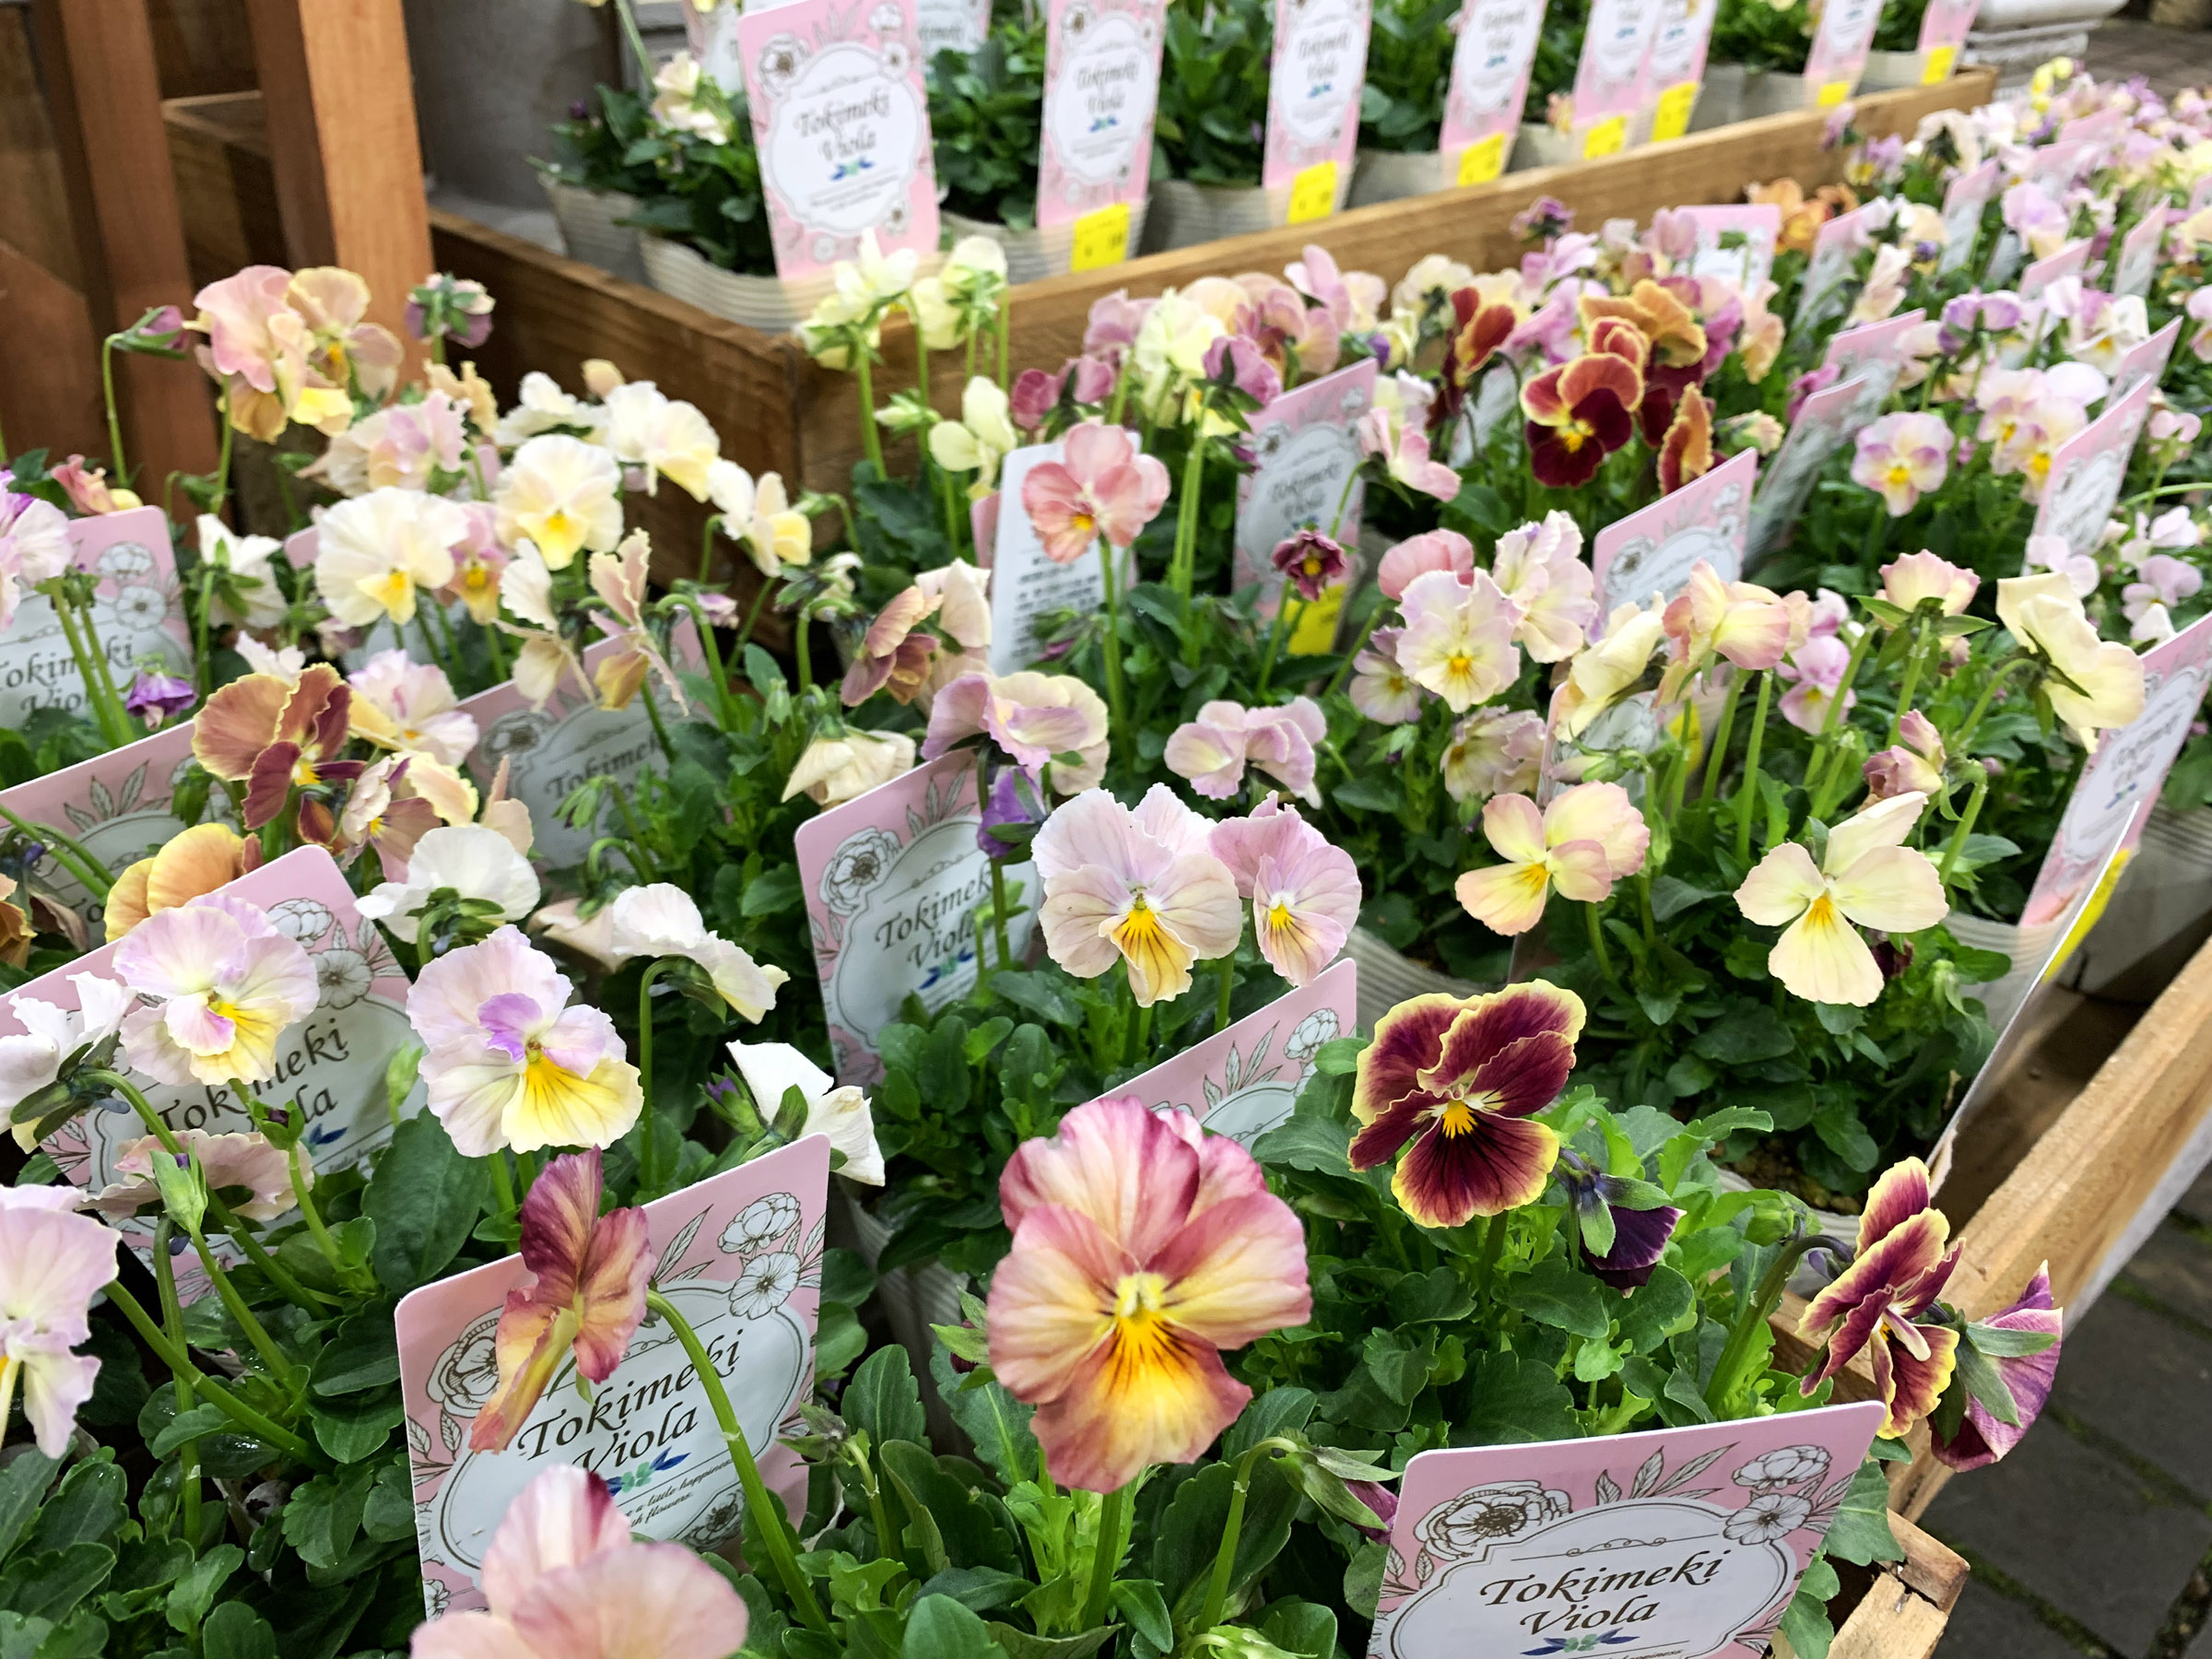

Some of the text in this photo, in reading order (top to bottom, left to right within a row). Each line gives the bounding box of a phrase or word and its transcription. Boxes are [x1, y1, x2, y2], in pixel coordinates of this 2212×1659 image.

[876, 859, 993, 950] Tokimek
[572, 1401, 699, 1473] Viola
[1479, 1549, 1731, 1606] Tokimeki
[1519, 1594, 1660, 1635] Viola
